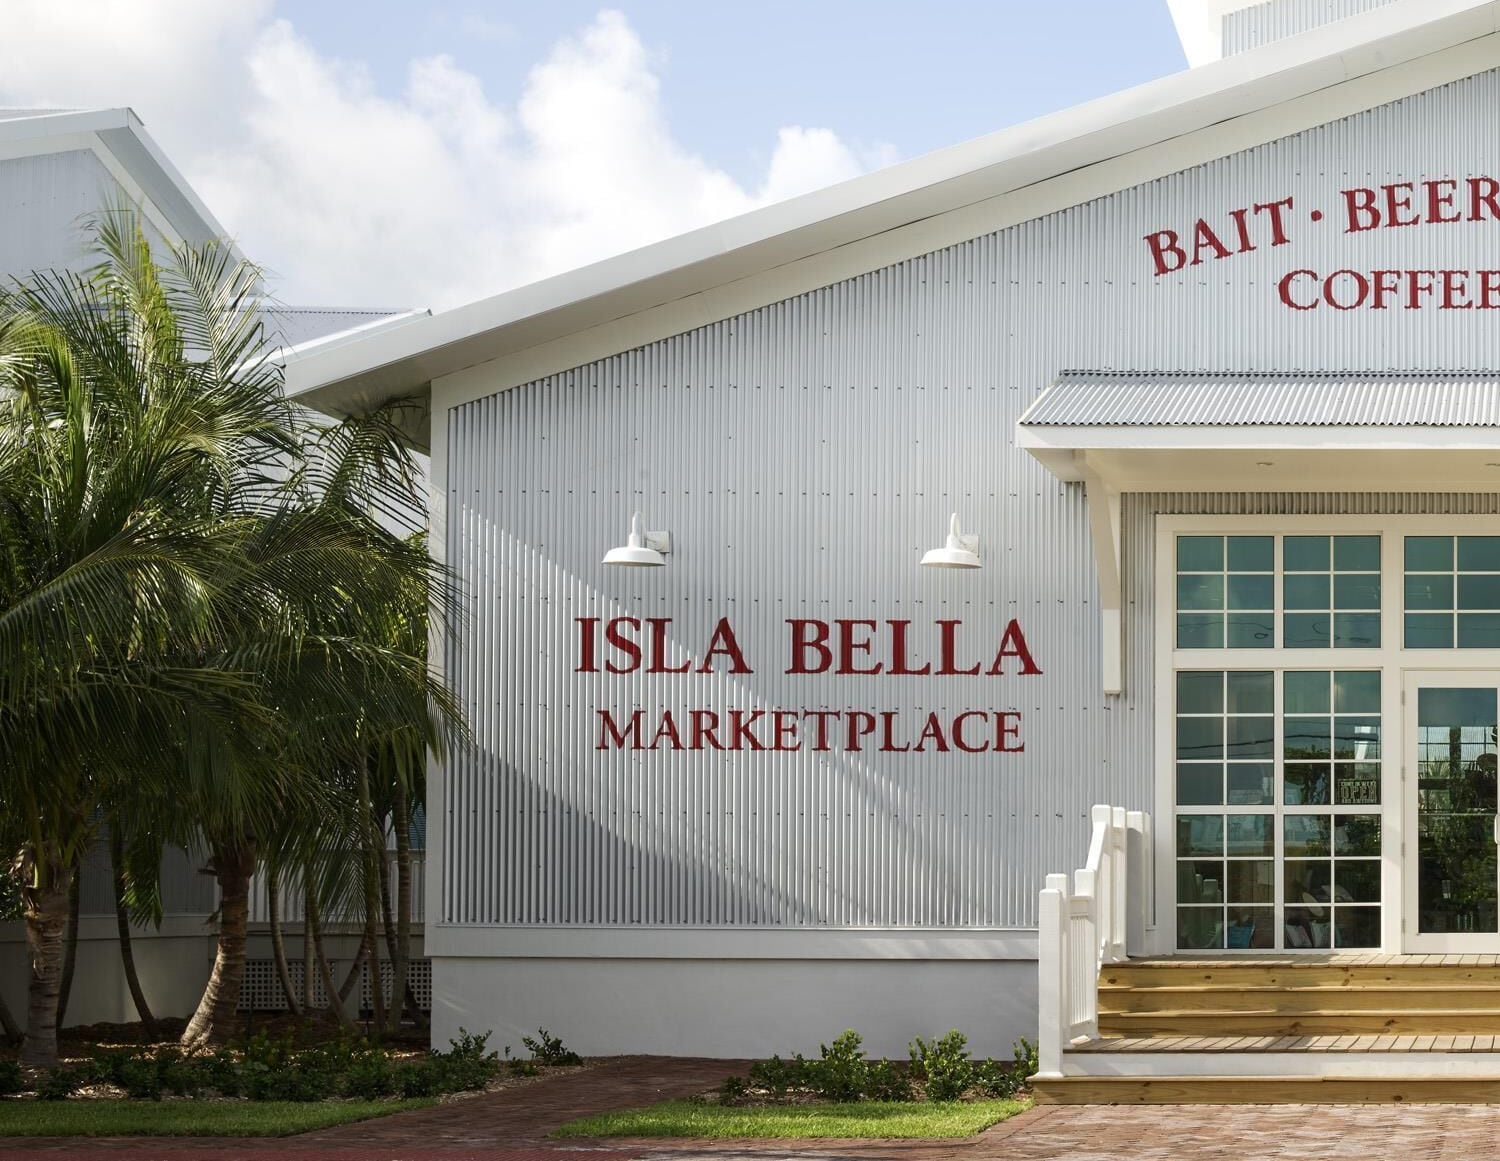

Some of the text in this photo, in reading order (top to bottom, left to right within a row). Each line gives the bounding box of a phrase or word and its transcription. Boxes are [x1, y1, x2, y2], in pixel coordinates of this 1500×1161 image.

[1143, 196, 1294, 277] BAIT
[574, 616, 1043, 676] ISLA BELLA
[595, 709, 1026, 753] MARKETPLACE
